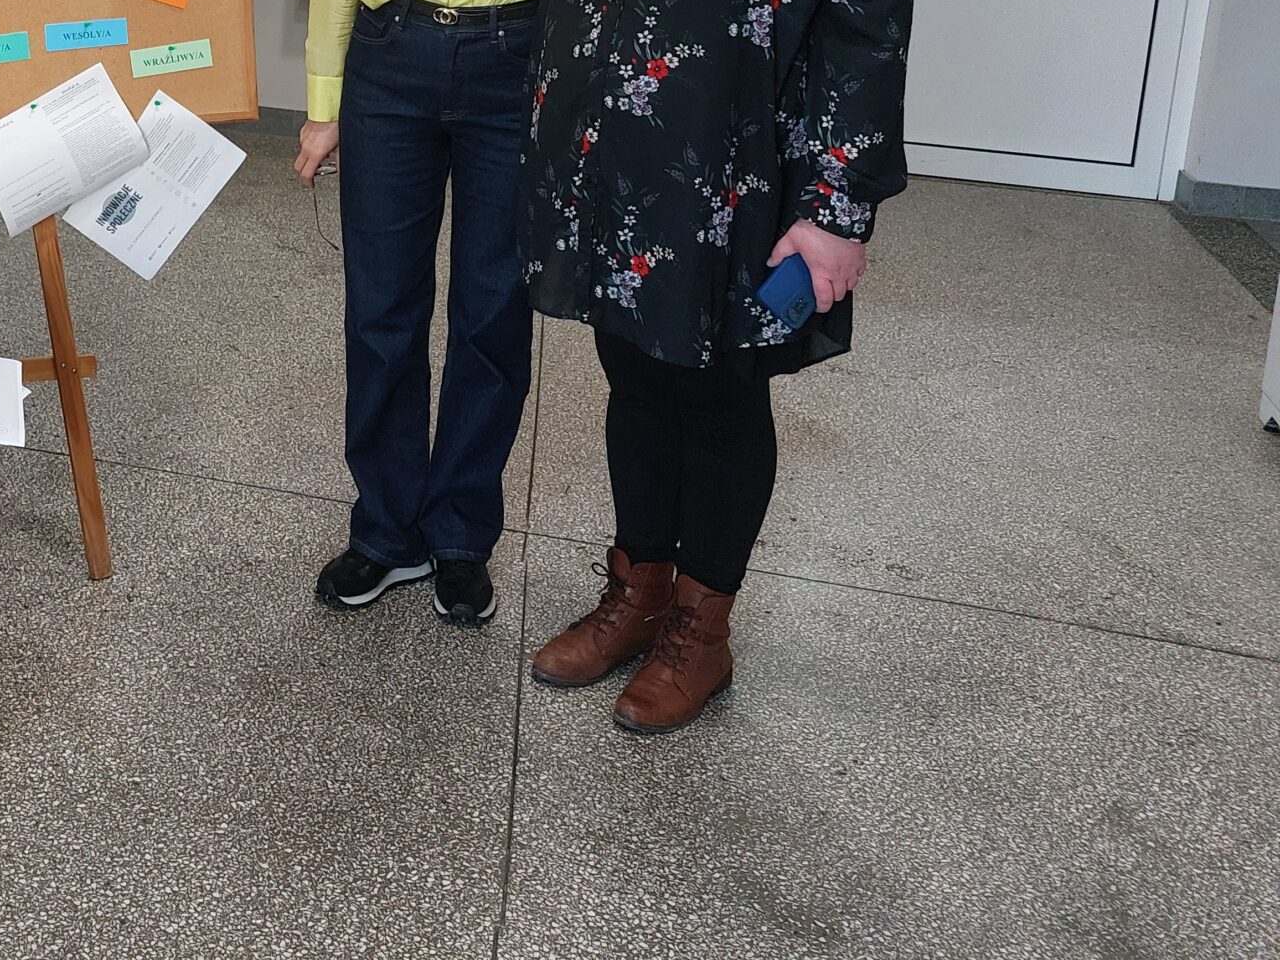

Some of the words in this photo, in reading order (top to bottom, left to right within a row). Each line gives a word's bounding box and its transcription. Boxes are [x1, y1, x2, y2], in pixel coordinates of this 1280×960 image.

[143, 51, 204, 68] WRAŻLIWY/A
[95, 183, 133, 227] INNOWACJE
[106, 190, 144, 235] SPOŁECZNE
